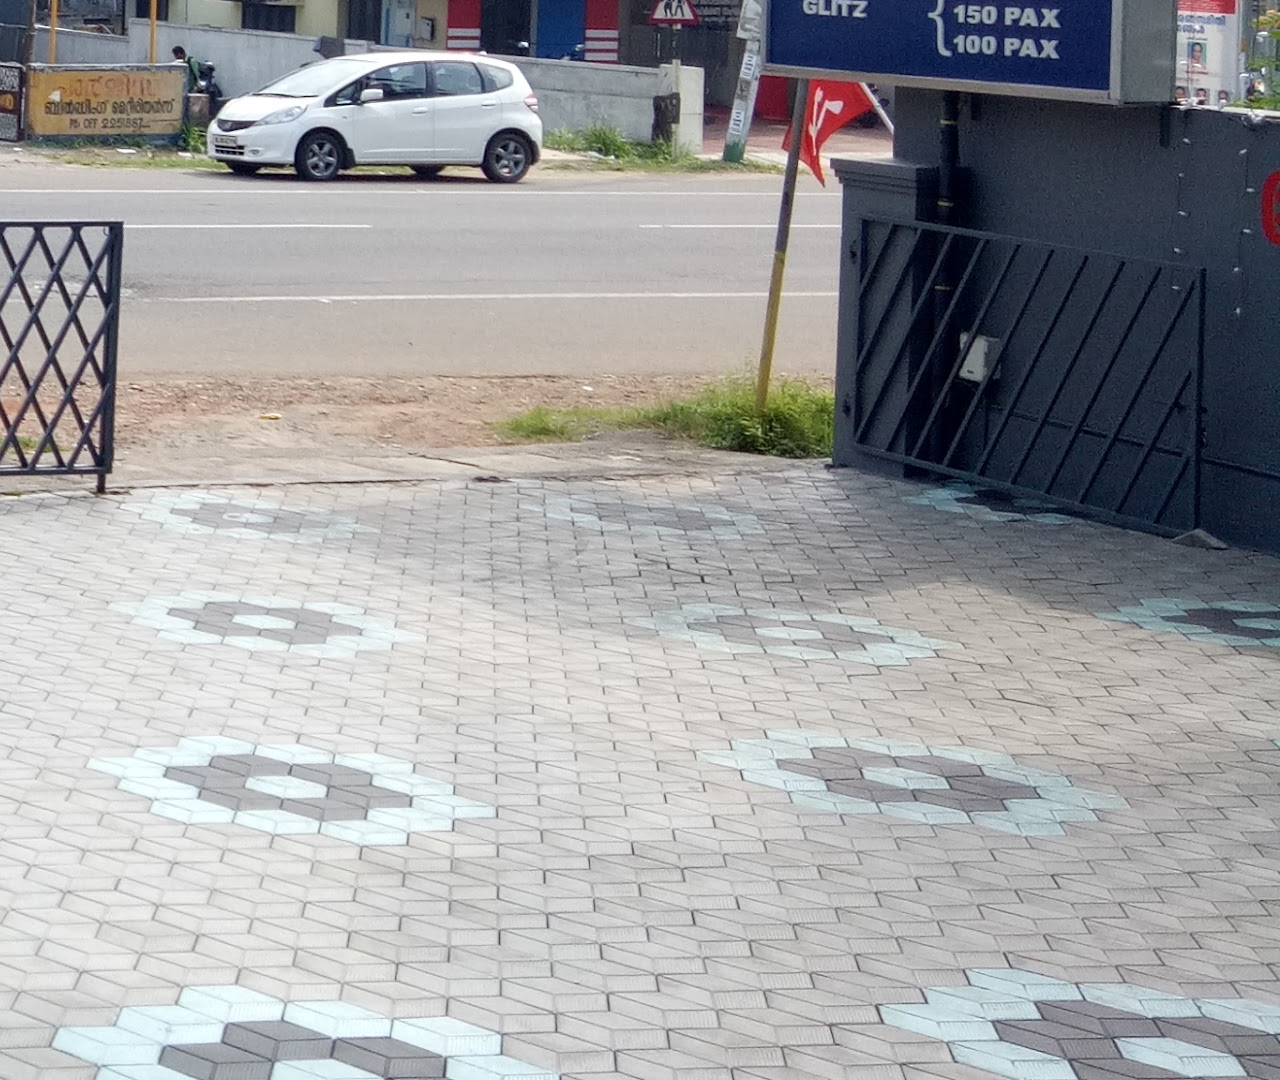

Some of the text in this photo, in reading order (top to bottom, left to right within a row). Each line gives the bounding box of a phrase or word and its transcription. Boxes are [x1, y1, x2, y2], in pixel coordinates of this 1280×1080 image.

[953, 5, 1061, 28] 150 PAX
[953, 35, 1060, 59] 100 PAX
